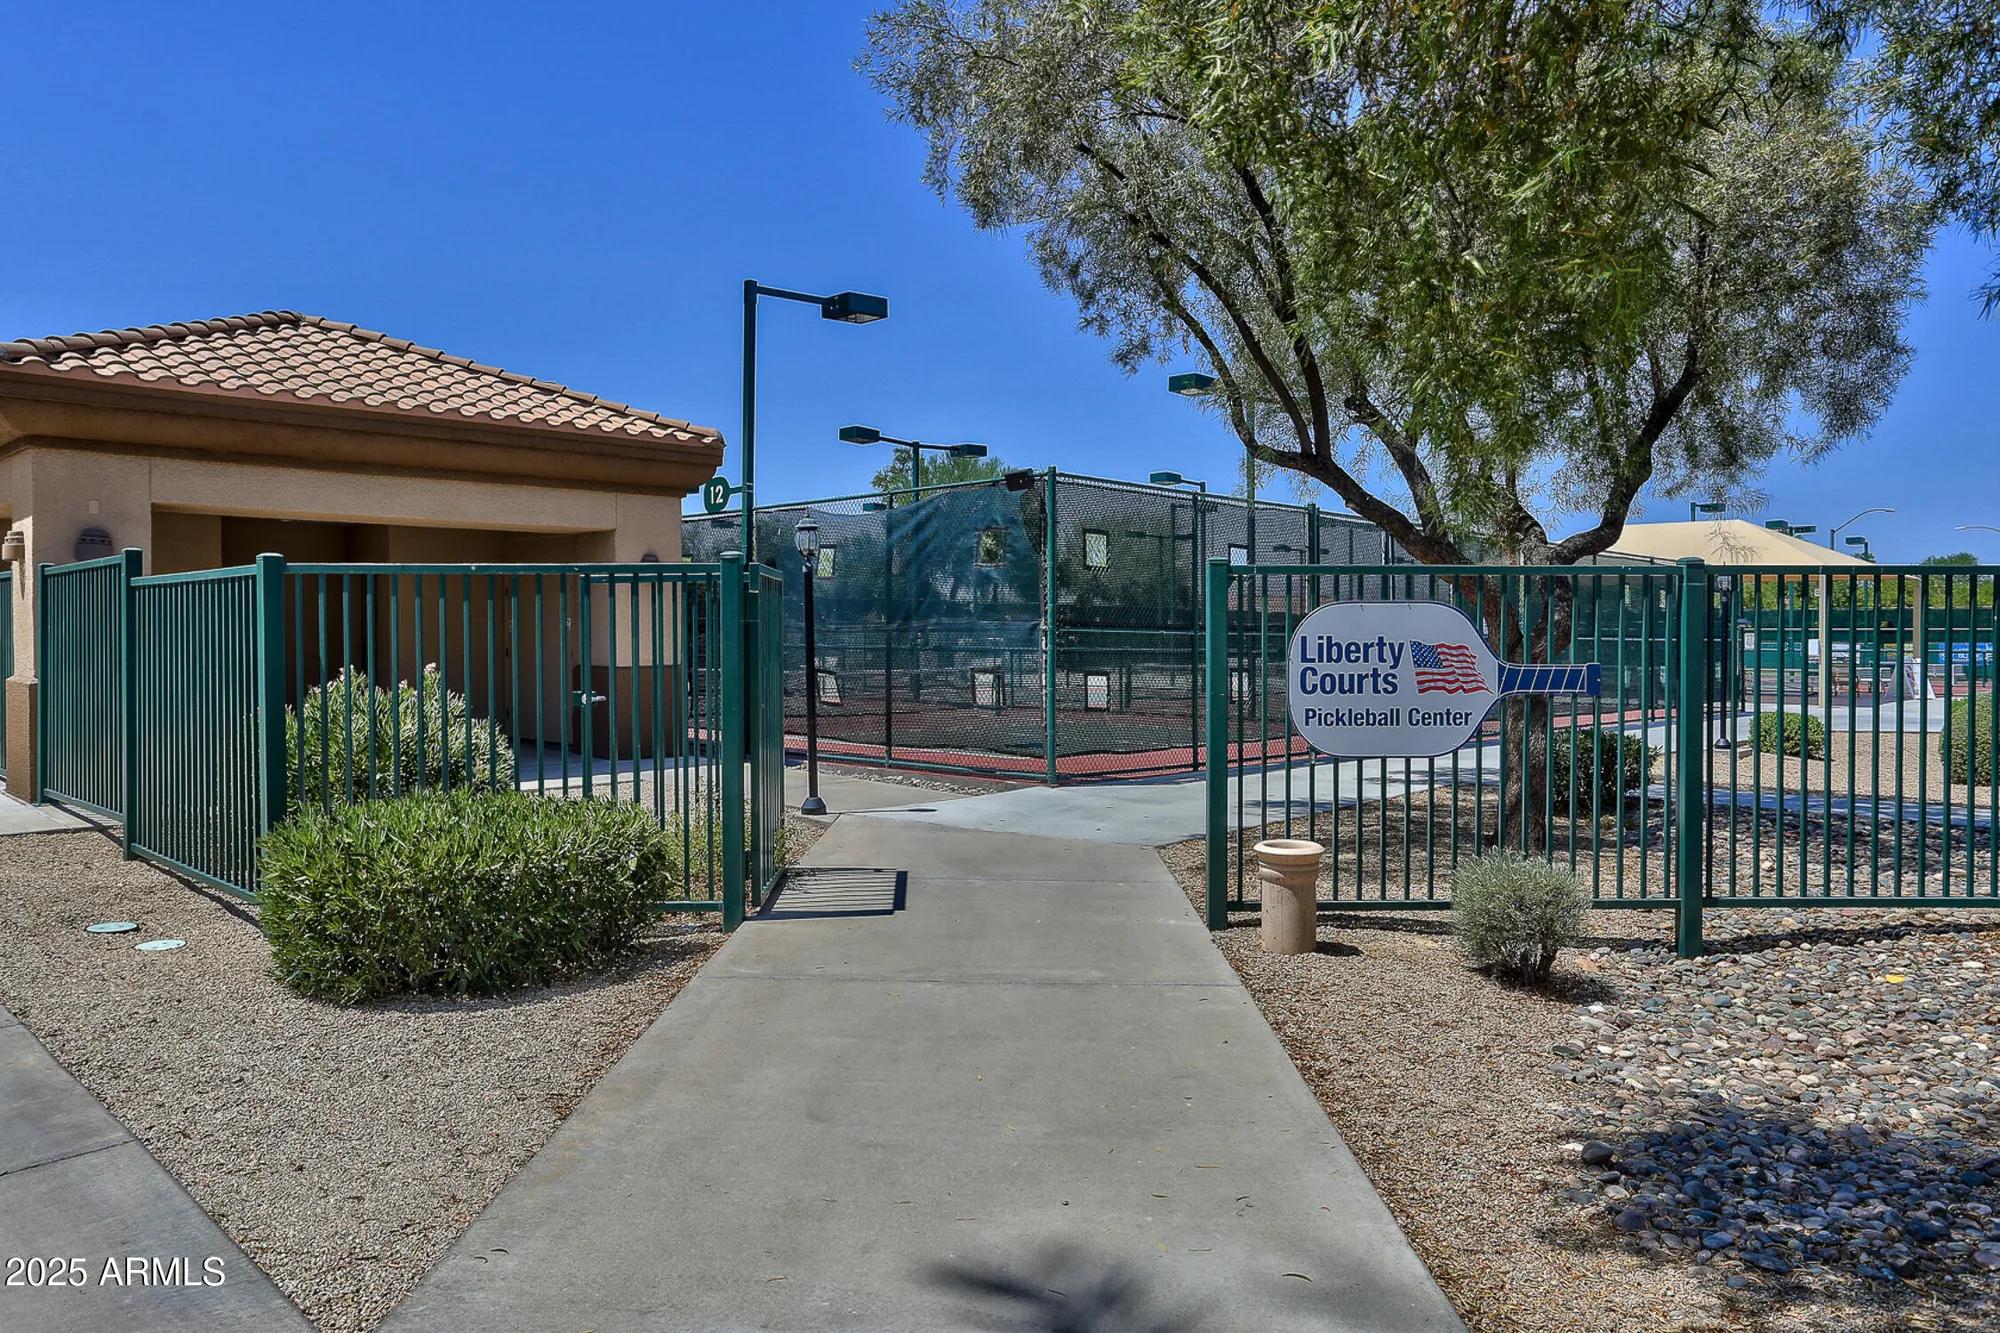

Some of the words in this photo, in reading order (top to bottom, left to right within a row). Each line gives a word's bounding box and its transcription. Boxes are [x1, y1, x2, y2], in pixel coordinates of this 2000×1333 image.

[710, 484, 724, 504] 12
[1300, 635, 1405, 670] Liberty
[1300, 666, 1399, 695] Courts
[1304, 707, 1401, 727] Pickleball
[1407, 707, 1473, 727] Center
